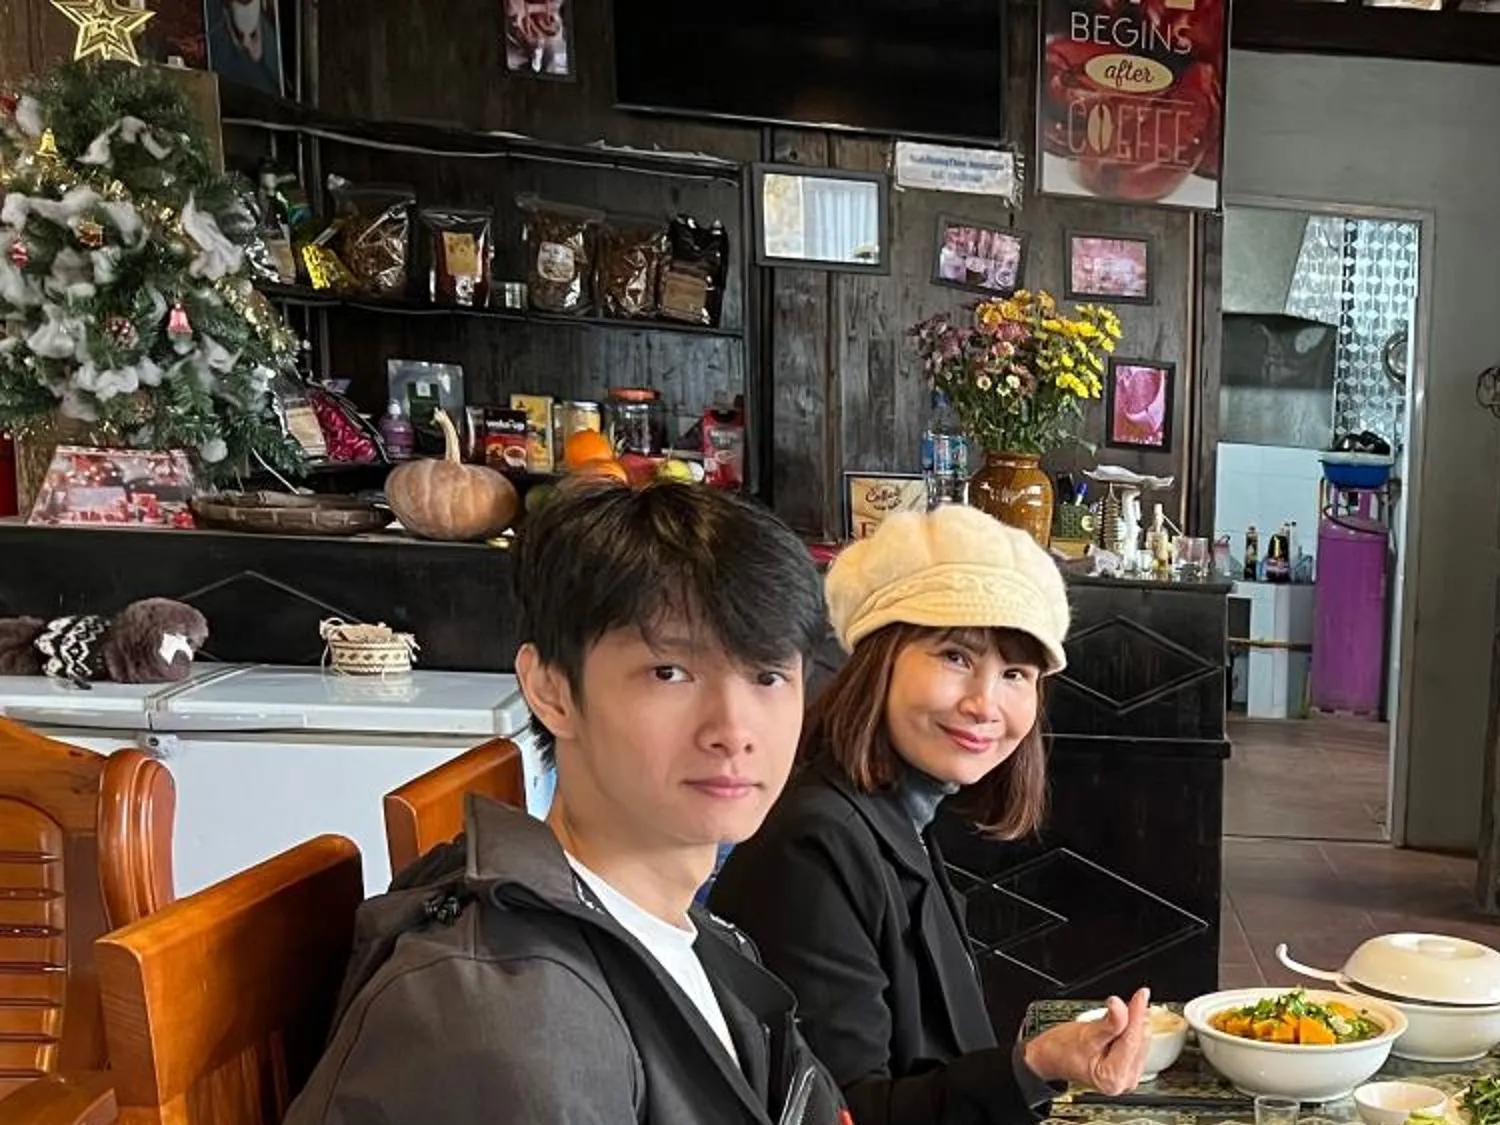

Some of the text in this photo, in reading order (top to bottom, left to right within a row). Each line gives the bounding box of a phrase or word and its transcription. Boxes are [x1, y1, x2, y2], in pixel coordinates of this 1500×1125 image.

[1071, 11, 1193, 54] BEGINS
[1103, 59, 1155, 88] after
[1068, 99, 1191, 165] COFFEE
